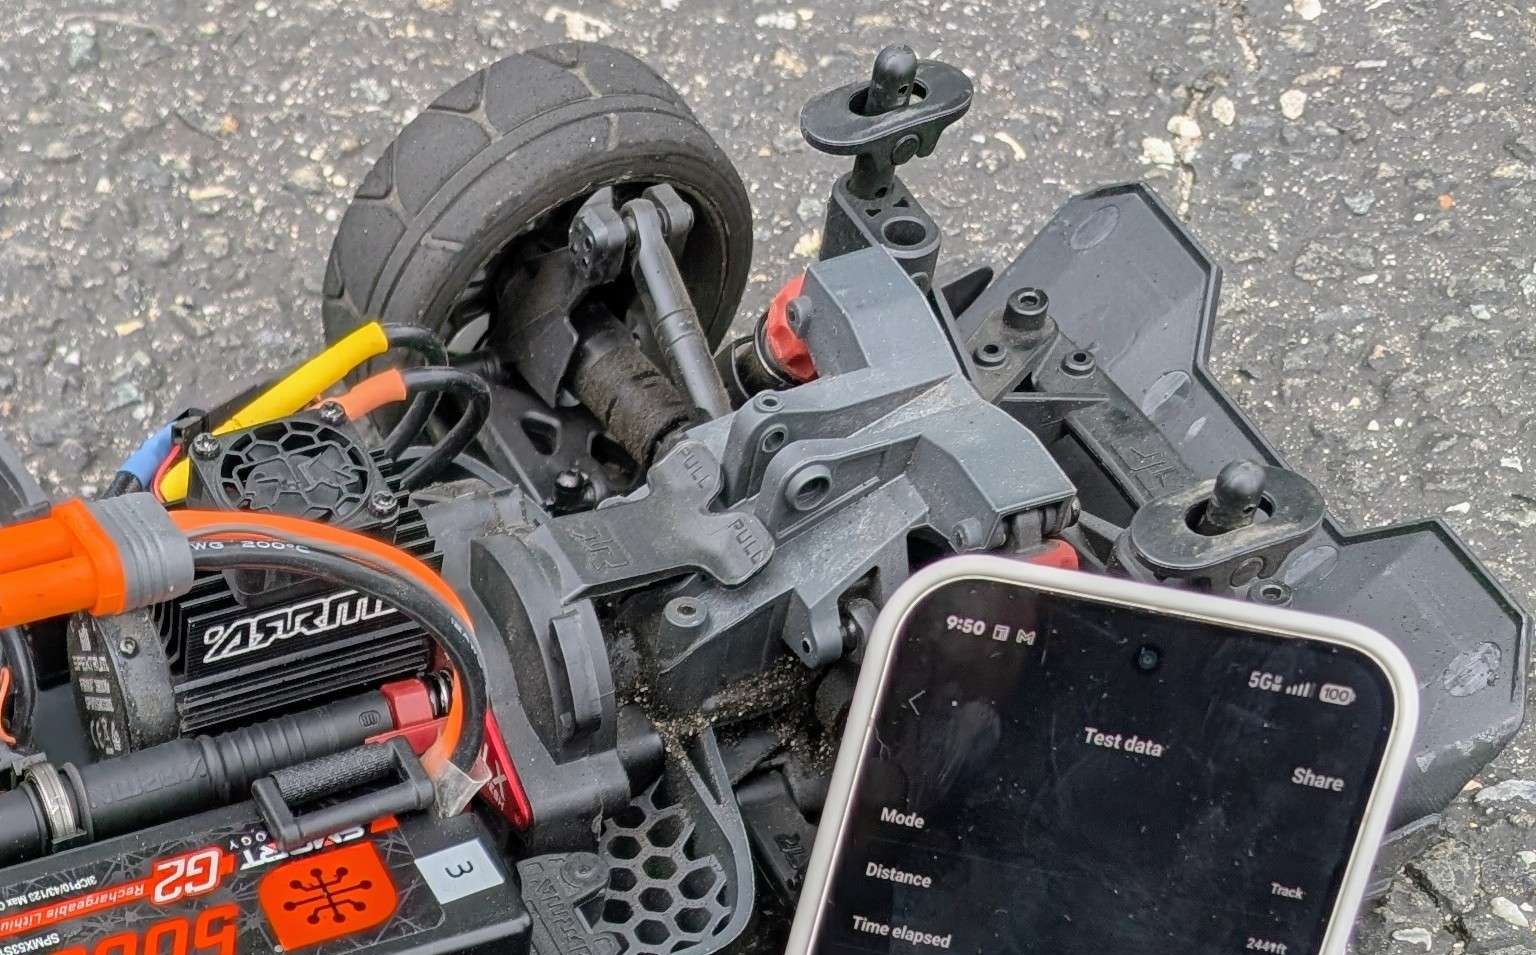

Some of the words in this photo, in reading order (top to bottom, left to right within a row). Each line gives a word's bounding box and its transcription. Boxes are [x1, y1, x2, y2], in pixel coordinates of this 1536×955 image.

[676, 446, 710, 491] PULL
[727, 517, 766, 563] PULL
[203, 590, 400, 664] ARRM
[946, 615, 986, 636] 9:50
[1323, 686, 1350, 701] 100
[1084, 727, 1122, 750] Test
[1124, 734, 1163, 757] data
[1291, 768, 1345, 792] Share
[880, 807, 925, 830] Mode
[152, 848, 221, 903] G2
[445, 860, 473, 878] 3
[865, 861, 932, 888] Distance
[6, 894, 29, 909] Max
[46, 882, 145, 920] Rechargeable
[1271, 882, 1303, 900] Track
[852, 915, 889, 937] Time
[892, 924, 952, 949] elapsed
